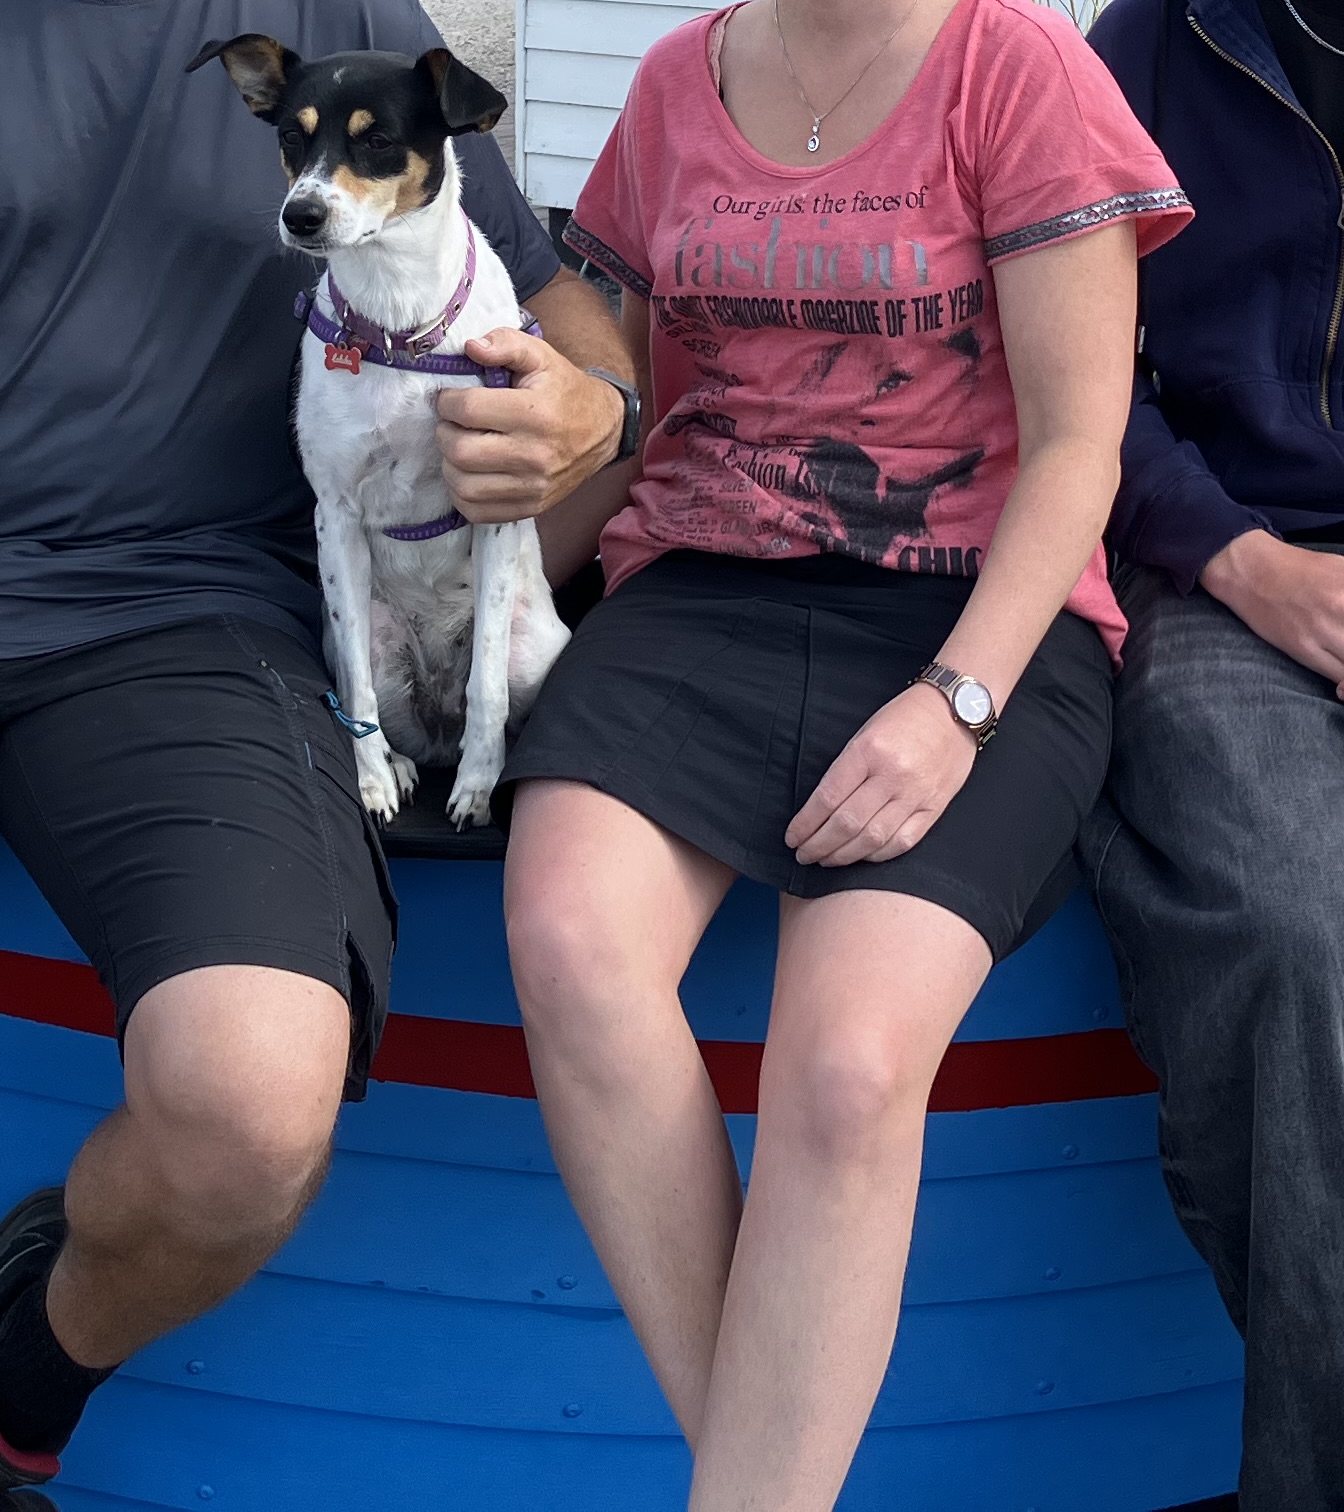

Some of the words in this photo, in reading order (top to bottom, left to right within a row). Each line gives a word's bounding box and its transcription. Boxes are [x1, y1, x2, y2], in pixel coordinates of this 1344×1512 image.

[713, 194, 757, 214] Our
[812, 192, 847, 214] the
[850, 190, 902, 214] faces
[905, 185, 929, 209] of
[675, 216, 932, 290] fashion
[800, 298, 883, 336] MAGAZINE
[884, 298, 908, 338] OF
[911, 292, 944, 334] THE
